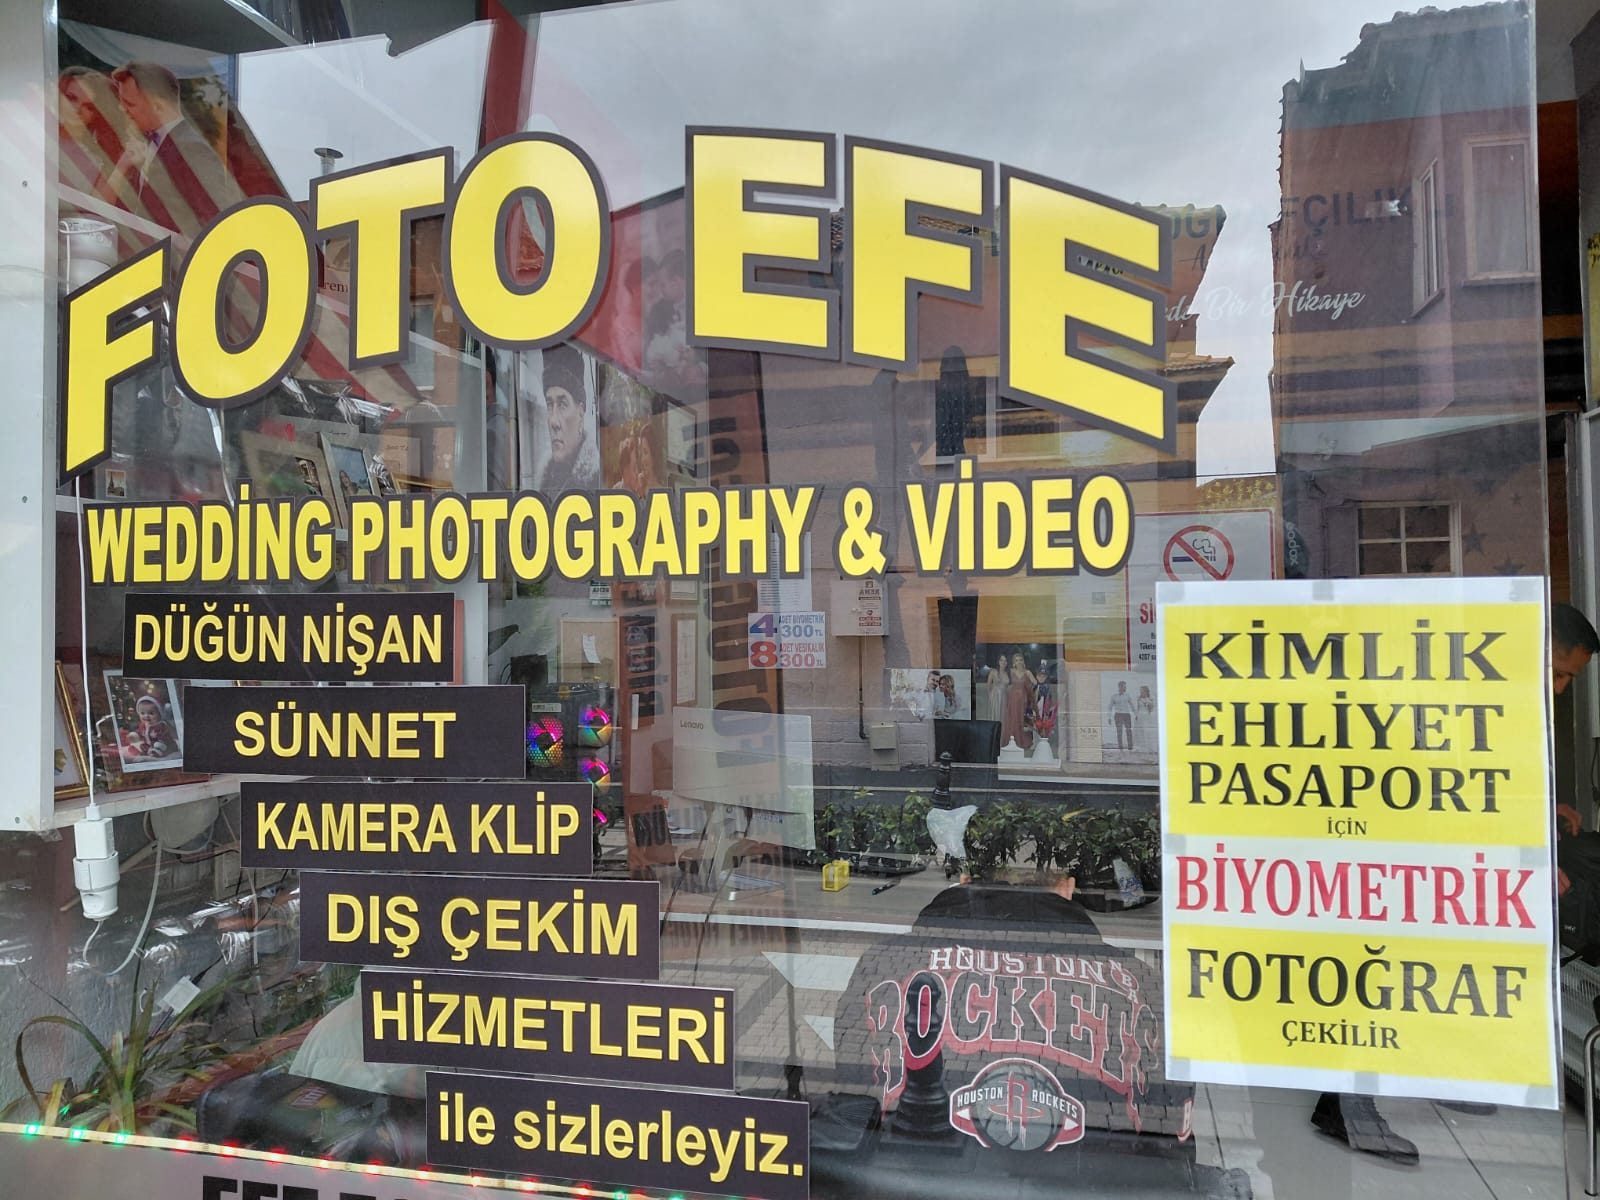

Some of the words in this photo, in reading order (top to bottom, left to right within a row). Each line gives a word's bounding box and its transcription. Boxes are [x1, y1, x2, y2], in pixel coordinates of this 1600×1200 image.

[64, 136, 606, 474] FOTO
[690, 130, 1170, 447] EFE
[1205, 285, 1249, 320] Bir
[1260, 280, 1366, 321] Hikaye
[86, 483, 333, 583] WEDDİNG
[351, 486, 816, 582] PHOTOGRAPHY
[838, 486, 888, 577] &
[905, 459, 1131, 571] VİDEO
[133, 601, 287, 663] DÜĞÜN
[302, 602, 442, 676] NİŞAN
[750, 613, 777, 637] 4
[751, 641, 778, 667] 8
[781, 624, 814, 638] 300
[1185, 619, 1508, 682] KİMLİK
[780, 653, 815, 667] 300
[233, 701, 457, 759] SÜNNET
[680, 720, 704, 729] Lenovo
[1186, 691, 1504, 752] EHLİYET
[1188, 761, 1511, 813] PASAPORT
[257, 802, 457, 853] KAMERA
[470, 791, 580, 855] KLİP
[1327, 816, 1368, 838] İÇİN
[1176, 843, 1537, 929] BİYOMETRİK
[327, 893, 421, 958] DIŞ
[440, 889, 638, 962] ÇEKİM
[929, 945, 1106, 984] HOUSTON
[1187, 944, 1528, 1018] FOTOĞRAF
[372, 980, 726, 1065] HİZMETLERİ
[866, 970, 1159, 1096] ROCKETS
[1282, 1018, 1401, 1050] ÇEKİLİR
[957, 1087, 1003, 1108] HOUSTON
[1032, 1089, 1078, 1119] ROCKETS
[439, 1091, 496, 1145] ile
[513, 1101, 804, 1183] sizlerleyiz.
